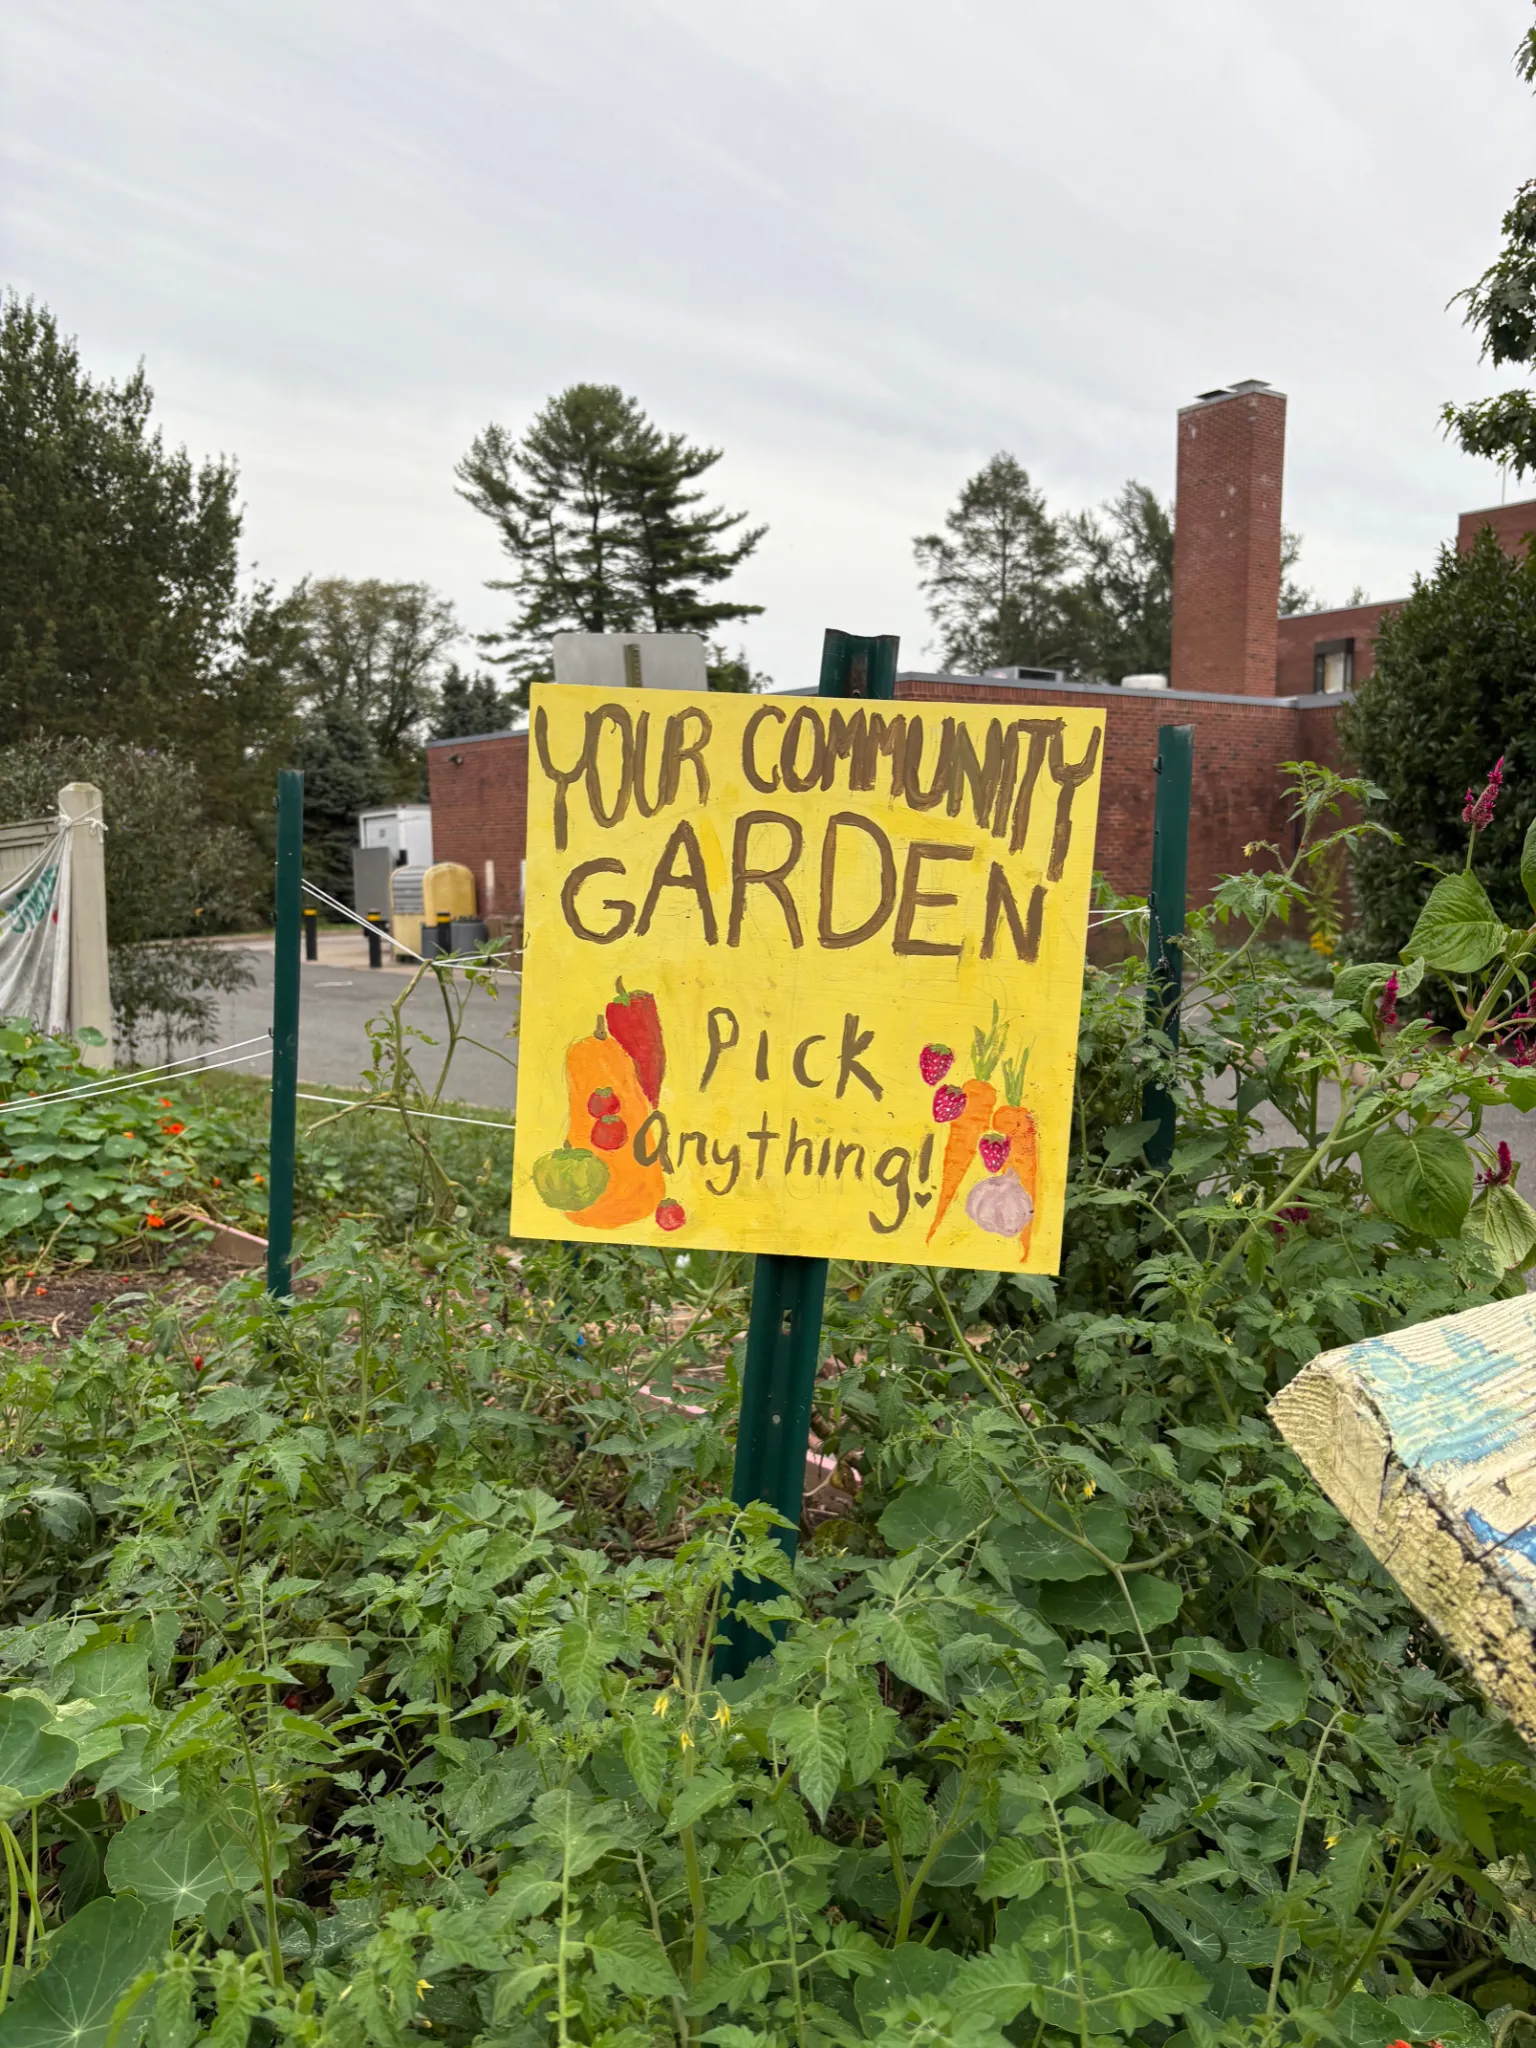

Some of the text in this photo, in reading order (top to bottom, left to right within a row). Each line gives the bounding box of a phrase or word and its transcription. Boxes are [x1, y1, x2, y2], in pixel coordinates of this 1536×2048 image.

[535, 703, 1101, 882] YOUR COMMUNITY
[560, 810, 1048, 964] GARDEN
